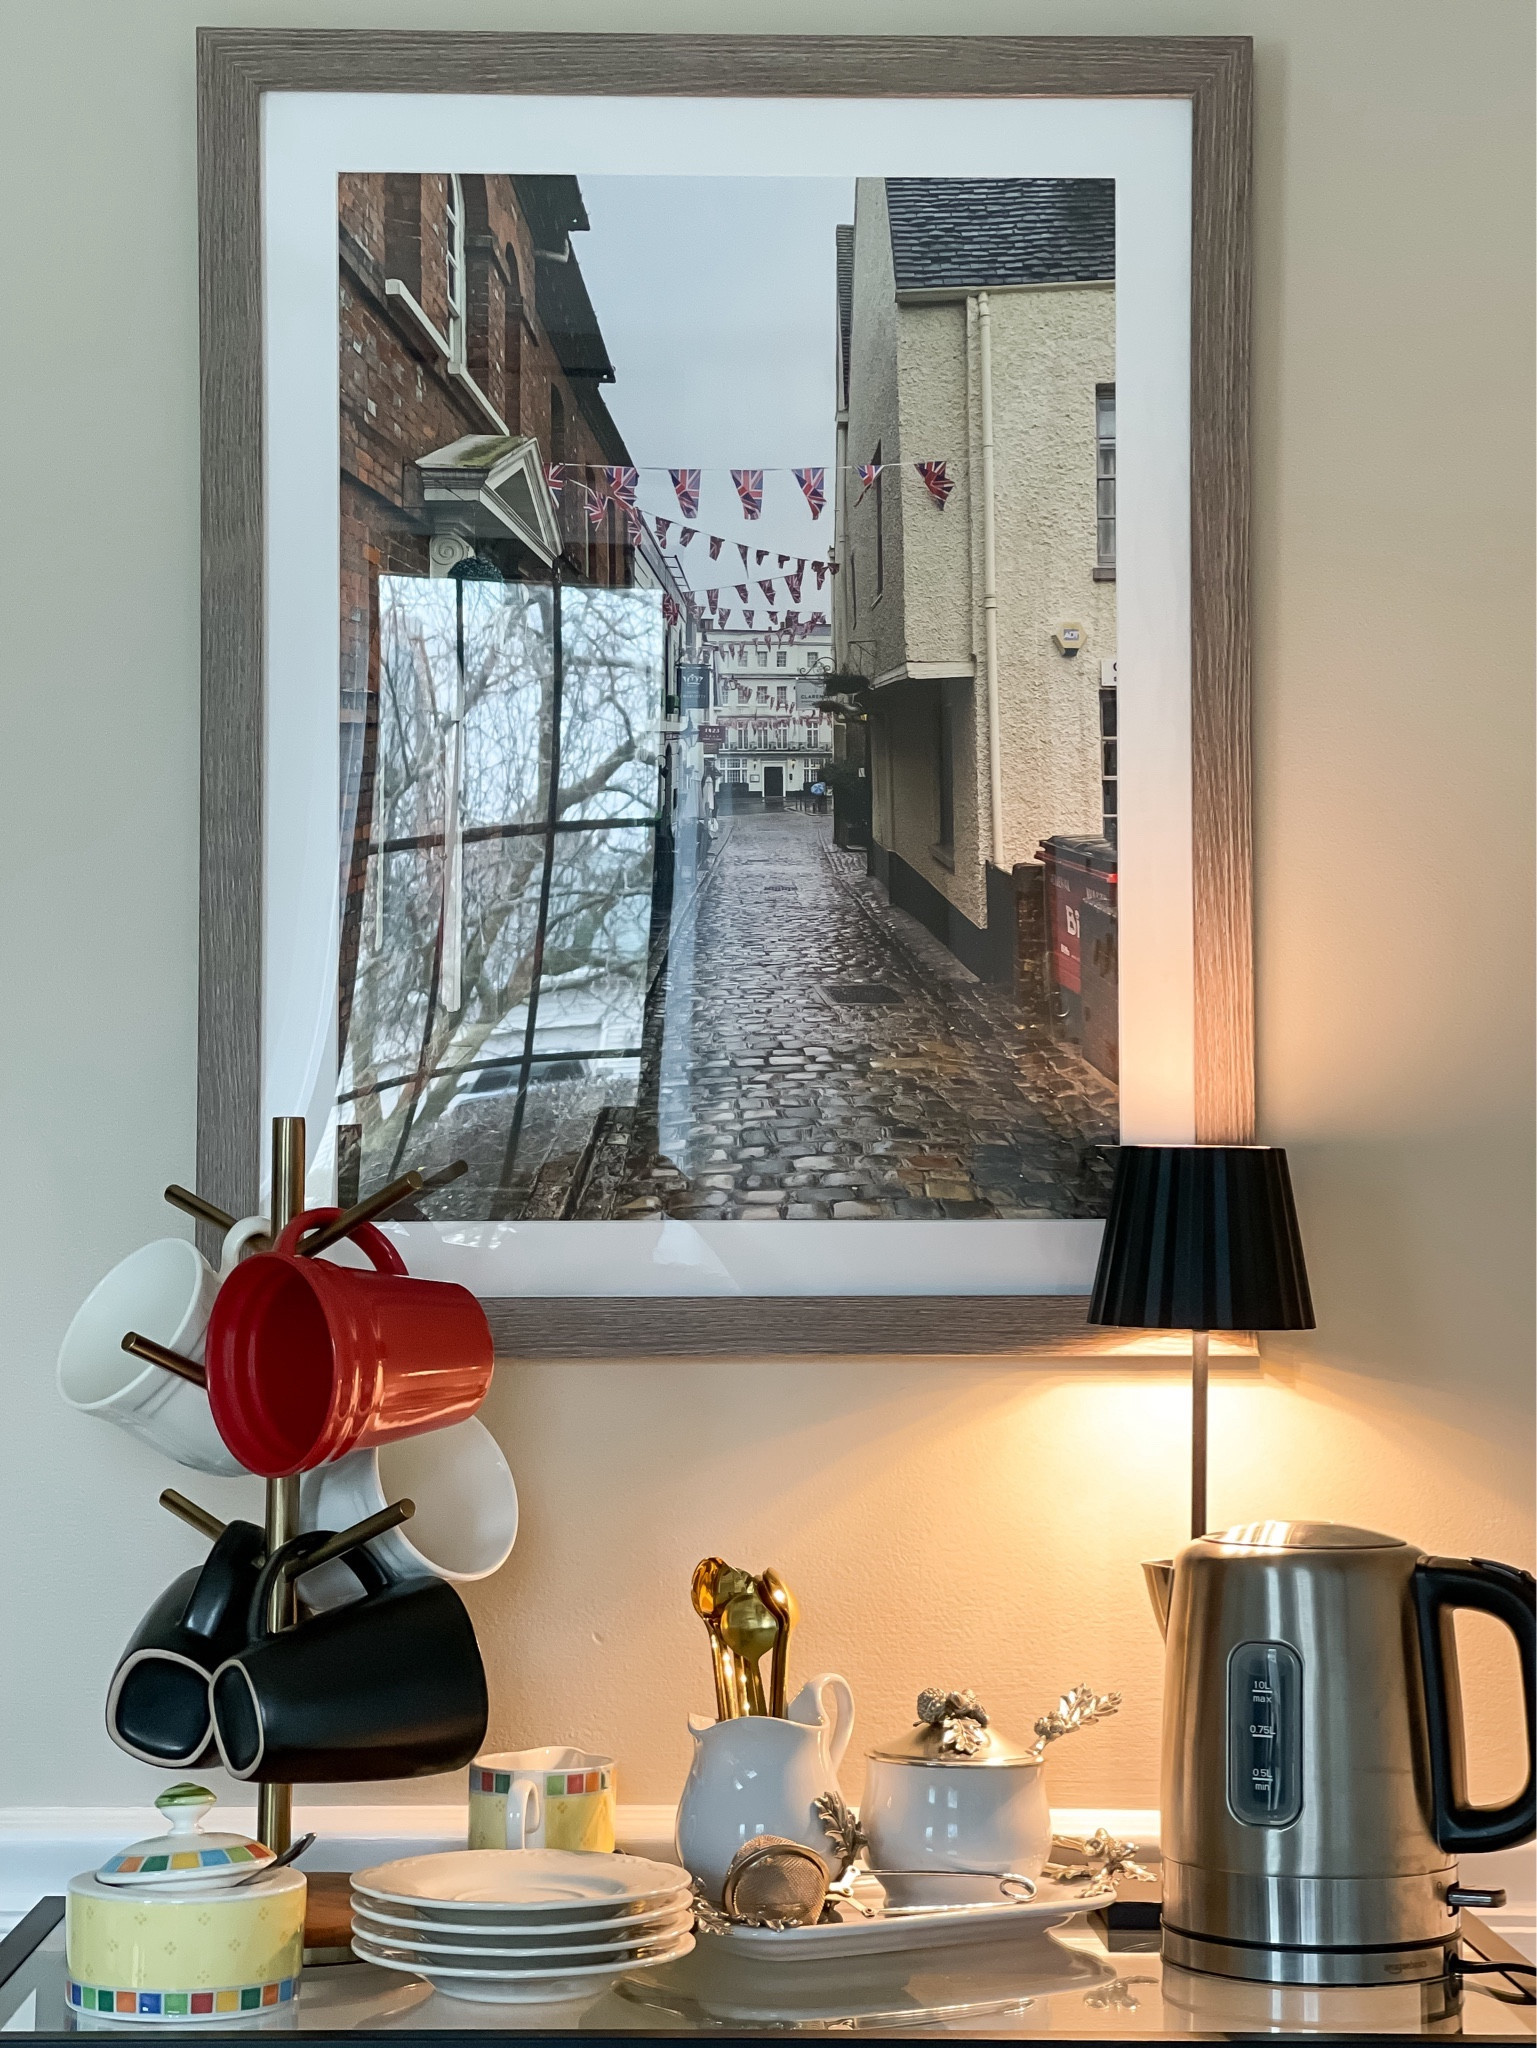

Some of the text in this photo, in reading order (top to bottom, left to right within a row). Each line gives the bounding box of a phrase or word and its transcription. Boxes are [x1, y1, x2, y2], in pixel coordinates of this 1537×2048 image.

[1253, 1695, 1273, 1703] max
[1249, 1725, 1276, 1735] 0.75L
[1255, 1783, 1271, 1791] min
